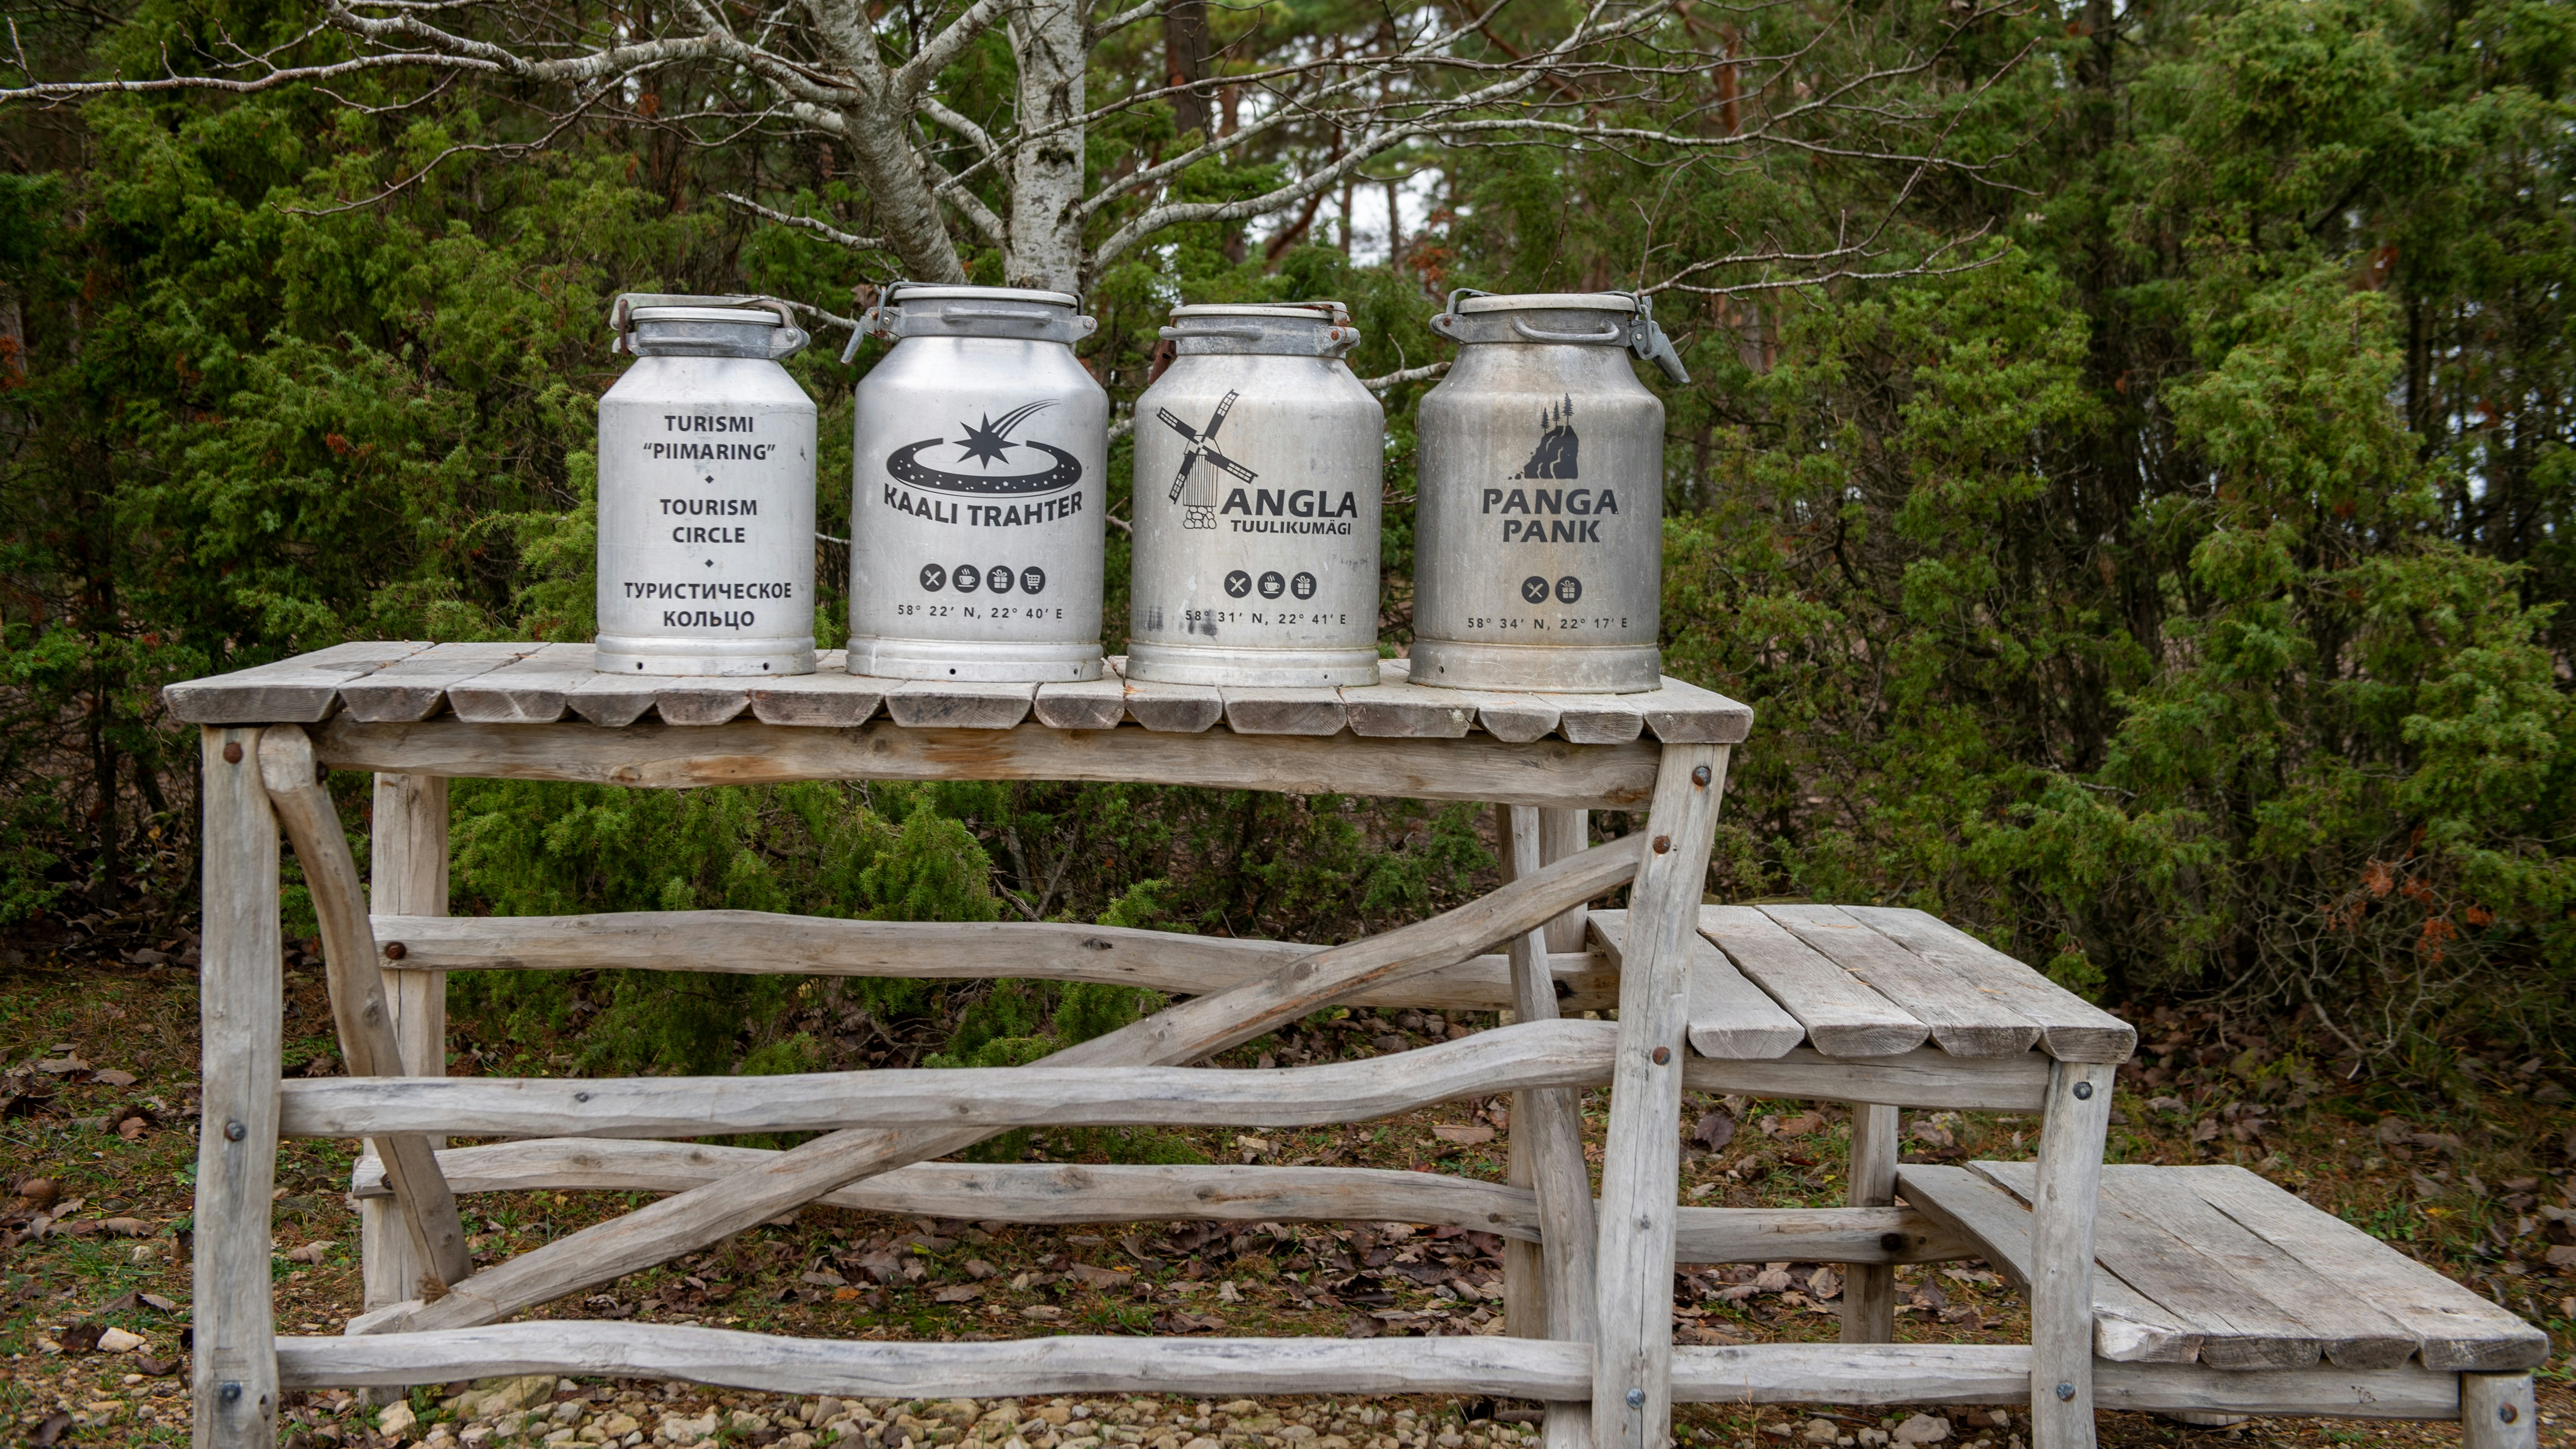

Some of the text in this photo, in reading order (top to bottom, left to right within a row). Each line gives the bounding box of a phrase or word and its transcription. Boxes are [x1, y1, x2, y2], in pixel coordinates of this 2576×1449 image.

[664, 415, 753, 433] TURISMI
[660, 499, 757, 515] TOURISM
[884, 483, 1083, 526] KAALI TRAHTER
[1220, 488, 1358, 518] ANGLA
[1482, 489, 1619, 515] PANGA
[673, 526, 745, 543] CIRCLE
[1231, 520, 1351, 535] TUULIKUMÄGI
[1503, 520, 1601, 543] PANK
[624, 582, 792, 599] ТУРИСТИЧЕСКОЕ
[898, 604, 921, 615] 58°
[964, 607, 981, 619] N,
[991, 607, 1017, 618] 22°
[1056, 608, 1062, 619] E
[1185, 609, 1209, 621] 58°
[1252, 613, 1268, 625] N,
[1279, 613, 1304, 624] 22°
[1340, 614, 1346, 625] E
[664, 611, 755, 631] КОЛЬЦО
[1468, 618, 1491, 628] 58°
[1534, 619, 1550, 631] N,
[1560, 618, 1585, 629] 22°
[1622, 618, 1627, 628] E
